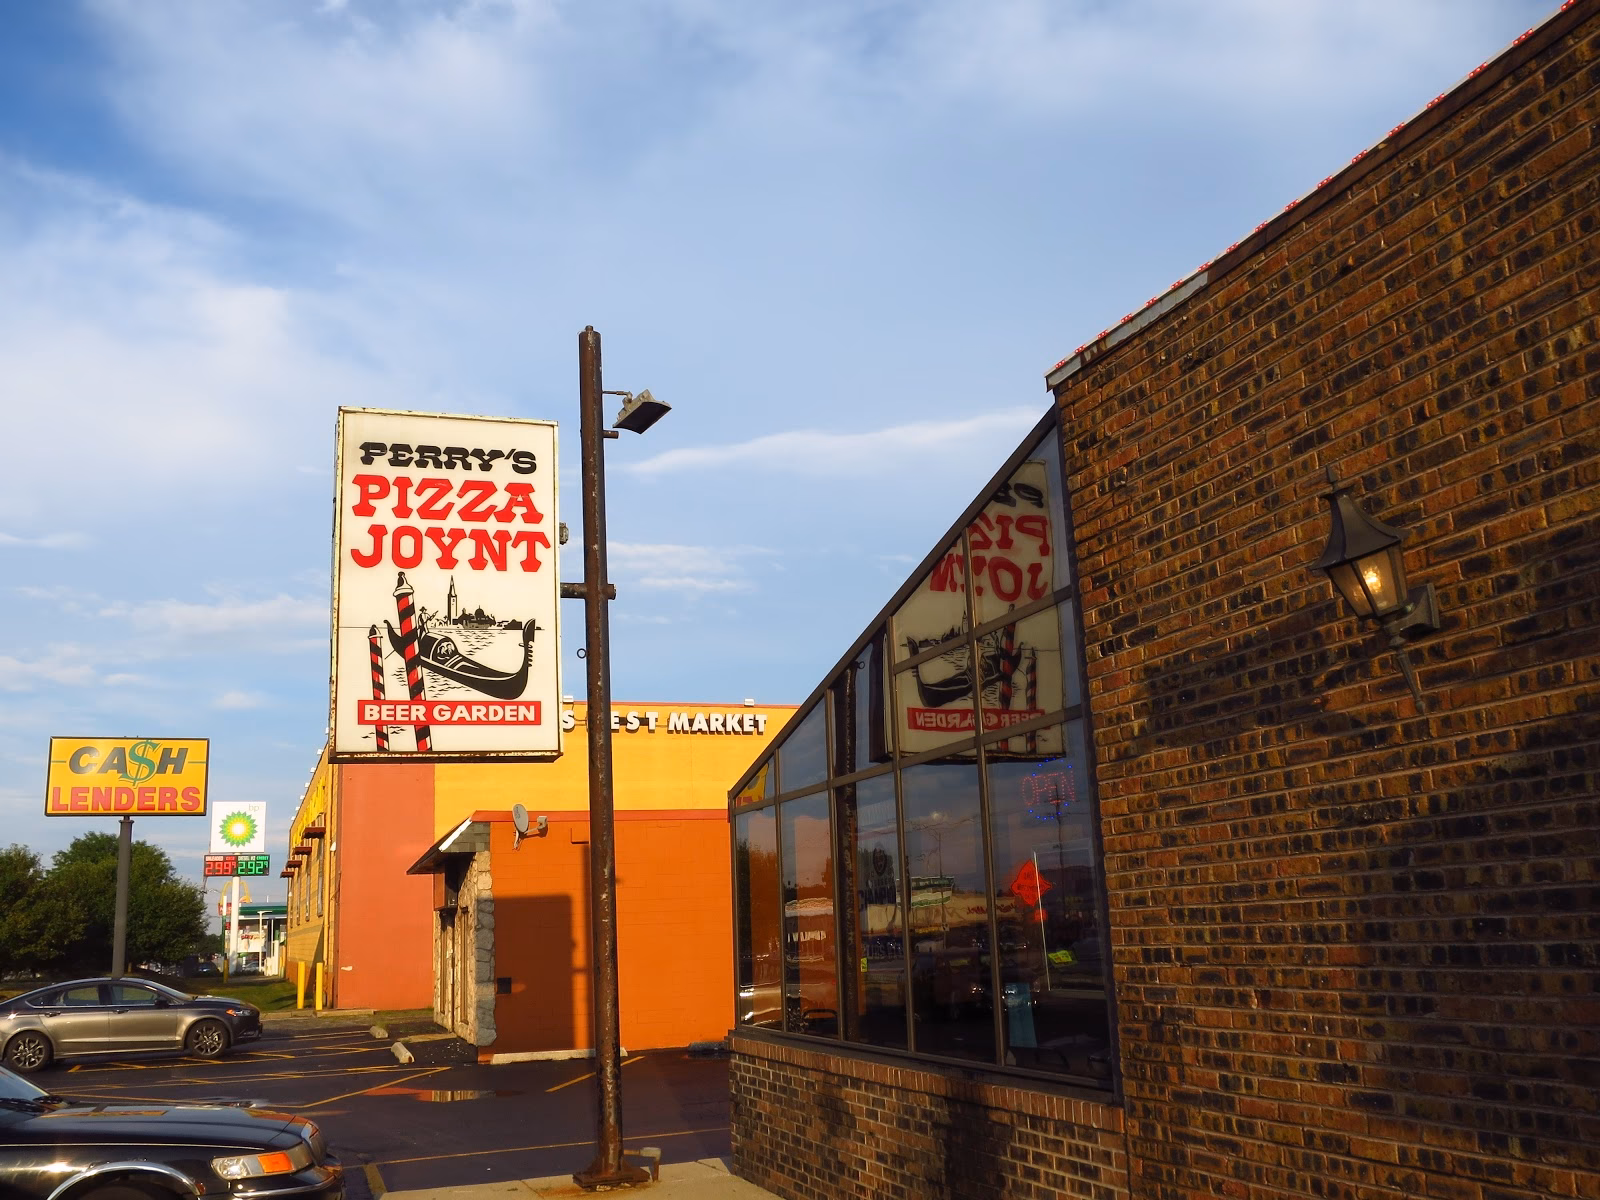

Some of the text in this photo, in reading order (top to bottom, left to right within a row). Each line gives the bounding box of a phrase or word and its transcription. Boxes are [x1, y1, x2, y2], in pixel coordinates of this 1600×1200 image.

[359, 441, 537, 475] PERRY'S
[351, 474, 544, 525] PIZZA
[350, 524, 551, 573] JOYNT
[364, 704, 535, 722] BEER GARDEN
[586, 710, 659, 732] EST
[667, 712, 768, 735] MARKET
[51, 786, 201, 812] LENDERS
[1021, 769, 1076, 806] OPEN
[248, 803, 260, 813] bp
